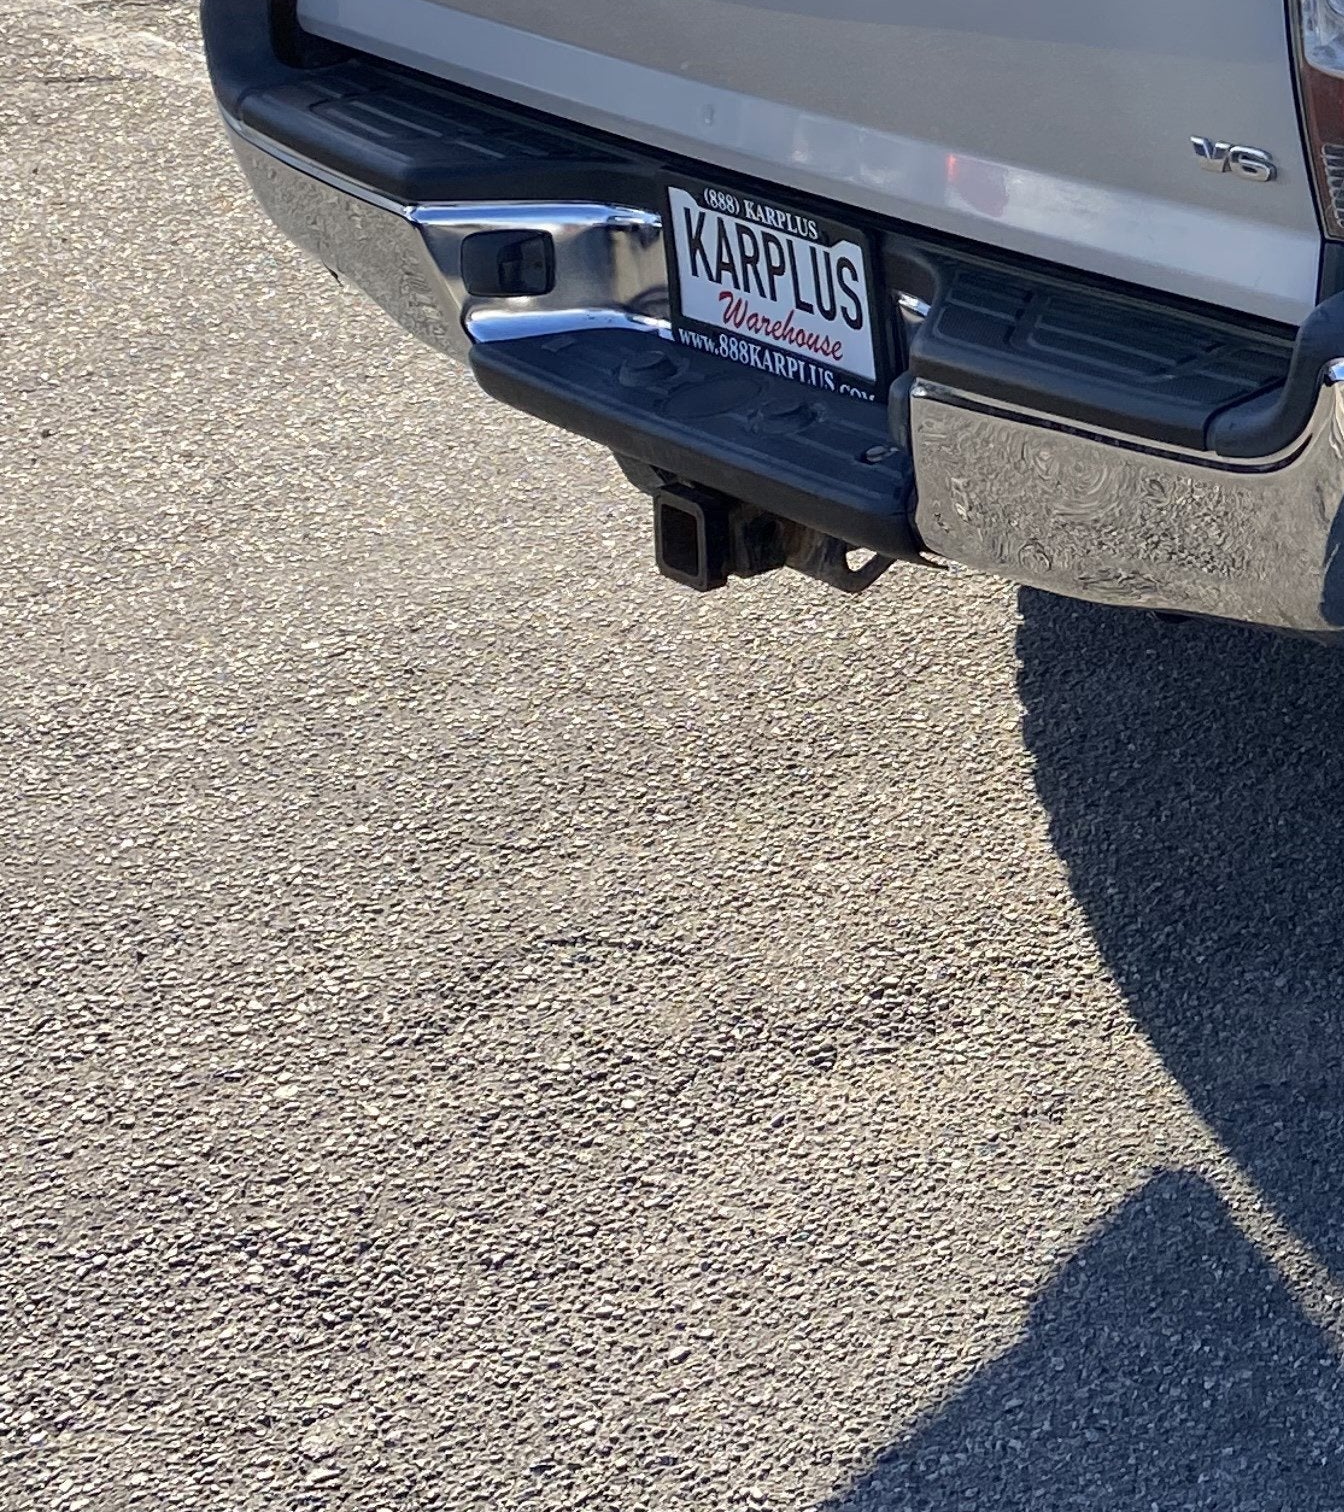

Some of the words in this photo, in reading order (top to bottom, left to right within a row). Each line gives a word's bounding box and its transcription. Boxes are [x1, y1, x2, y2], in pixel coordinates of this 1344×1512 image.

[1189, 134, 1278, 182] V6
[703, 187, 740, 214] (888)
[743, 199, 819, 240] KARPLUS
[683, 206, 864, 331] KARPLUS
[718, 290, 844, 362] Warehouse
